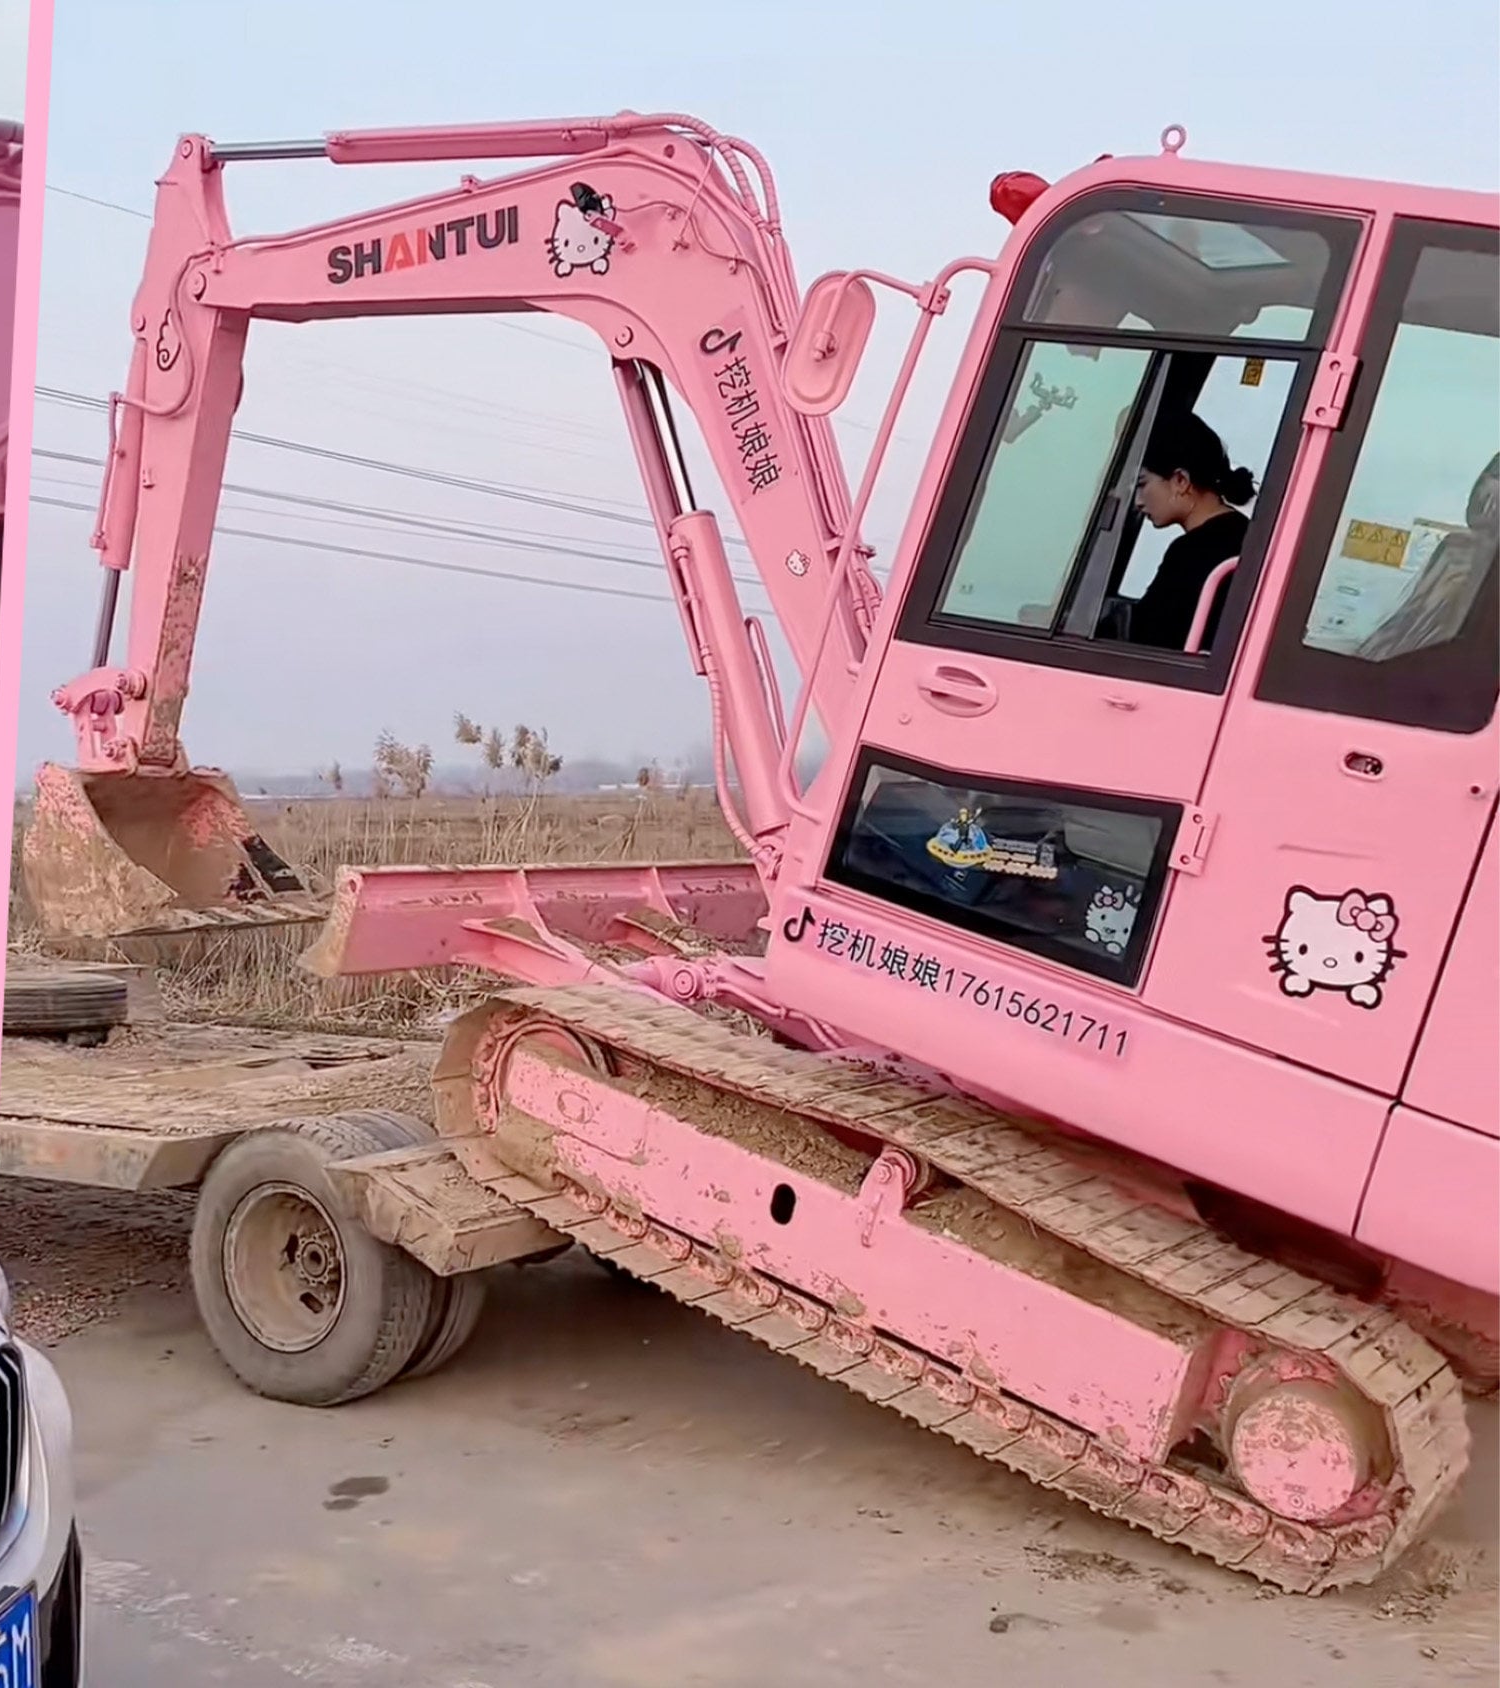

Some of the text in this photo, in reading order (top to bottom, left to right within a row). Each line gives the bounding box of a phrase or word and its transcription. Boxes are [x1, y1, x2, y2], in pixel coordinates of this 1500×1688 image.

[327, 205, 520, 286] SHANTUI
[712, 355, 784, 496] 挖机娘娘
[816, 918, 1130, 1057] 挖机娘娘17615621711
